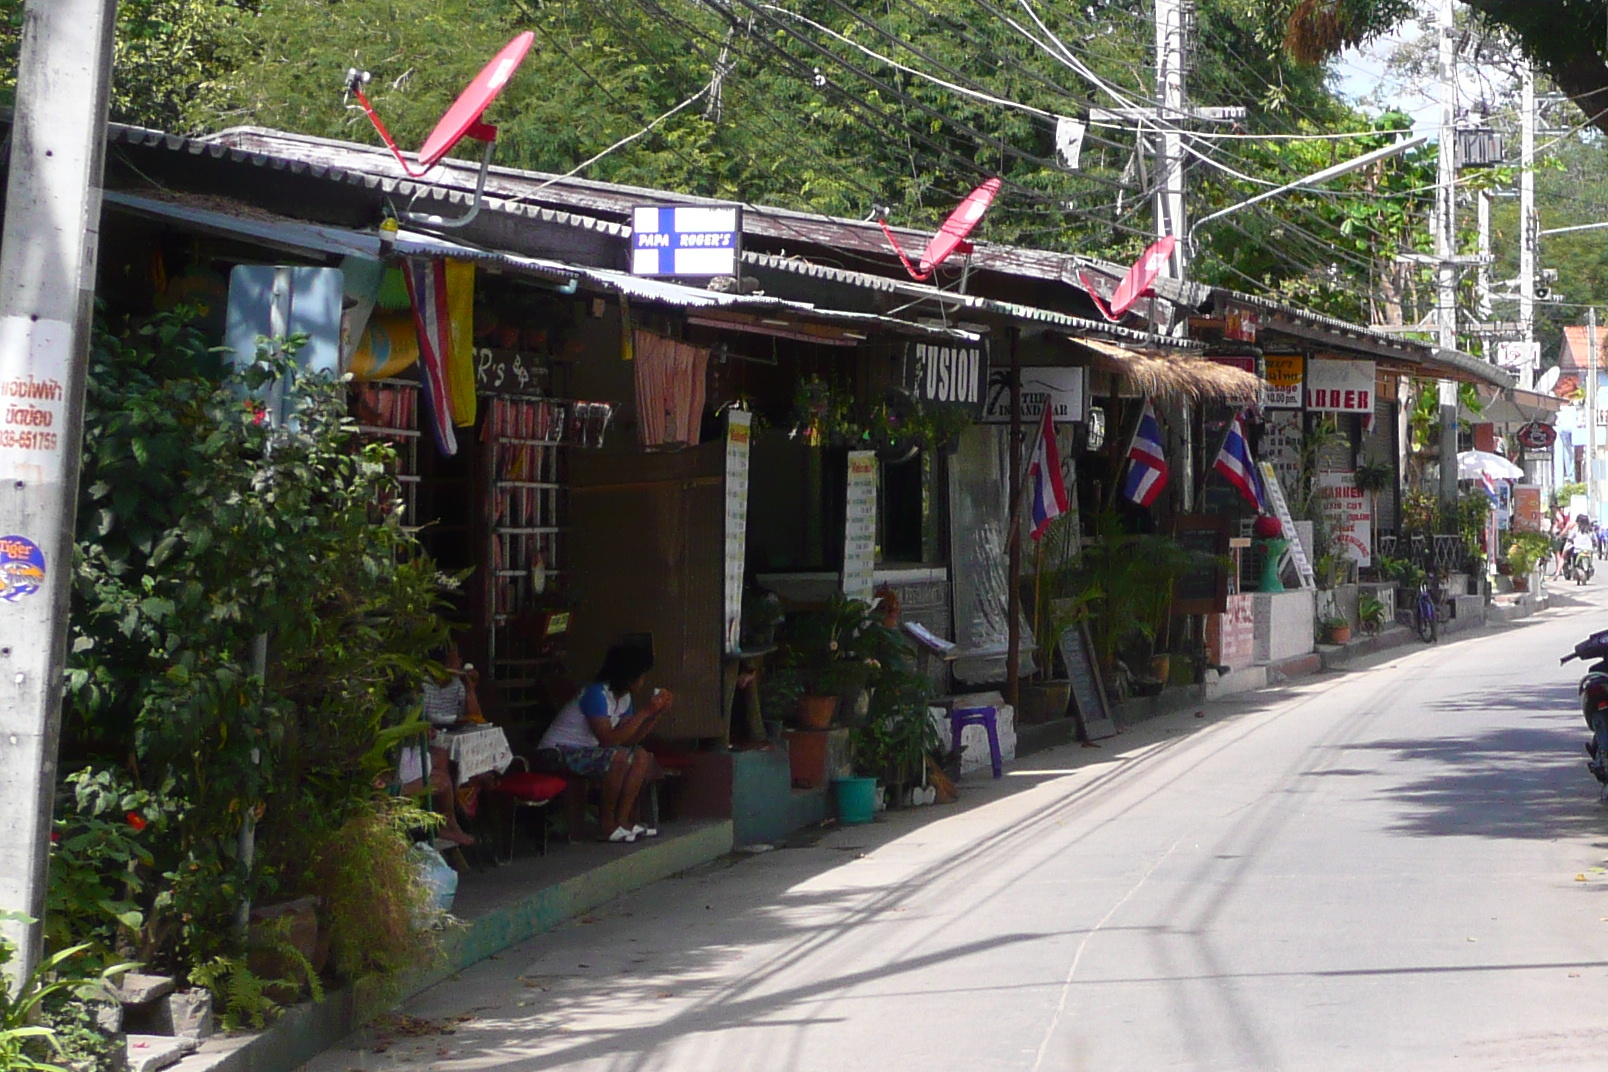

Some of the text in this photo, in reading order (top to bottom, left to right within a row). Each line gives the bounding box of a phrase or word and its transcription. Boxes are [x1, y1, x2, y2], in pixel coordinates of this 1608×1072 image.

[638, 233, 731, 247] PAPA ROGER'S
[914, 343, 980, 403] FUSION
